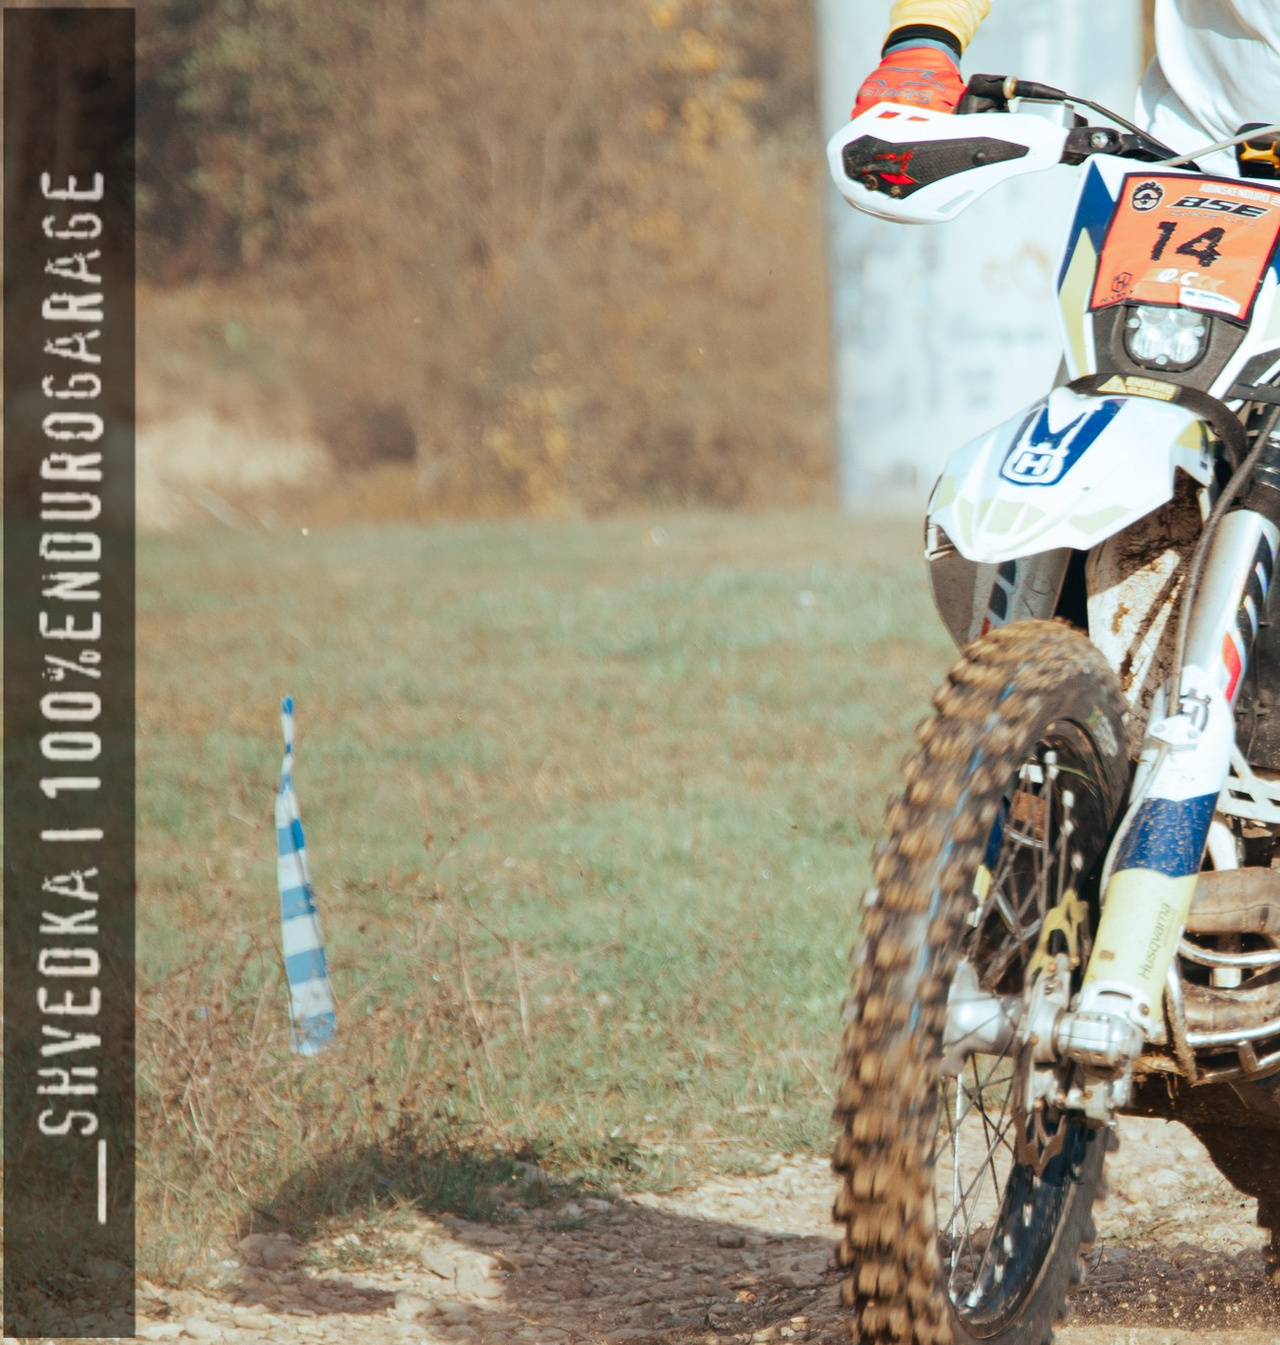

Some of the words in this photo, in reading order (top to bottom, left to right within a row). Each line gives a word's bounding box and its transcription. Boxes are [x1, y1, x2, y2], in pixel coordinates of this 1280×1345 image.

[1170, 196, 1272, 219] BSE
[1150, 221, 1226, 267] 14
[1137, 901, 1171, 980] Husqvarna
